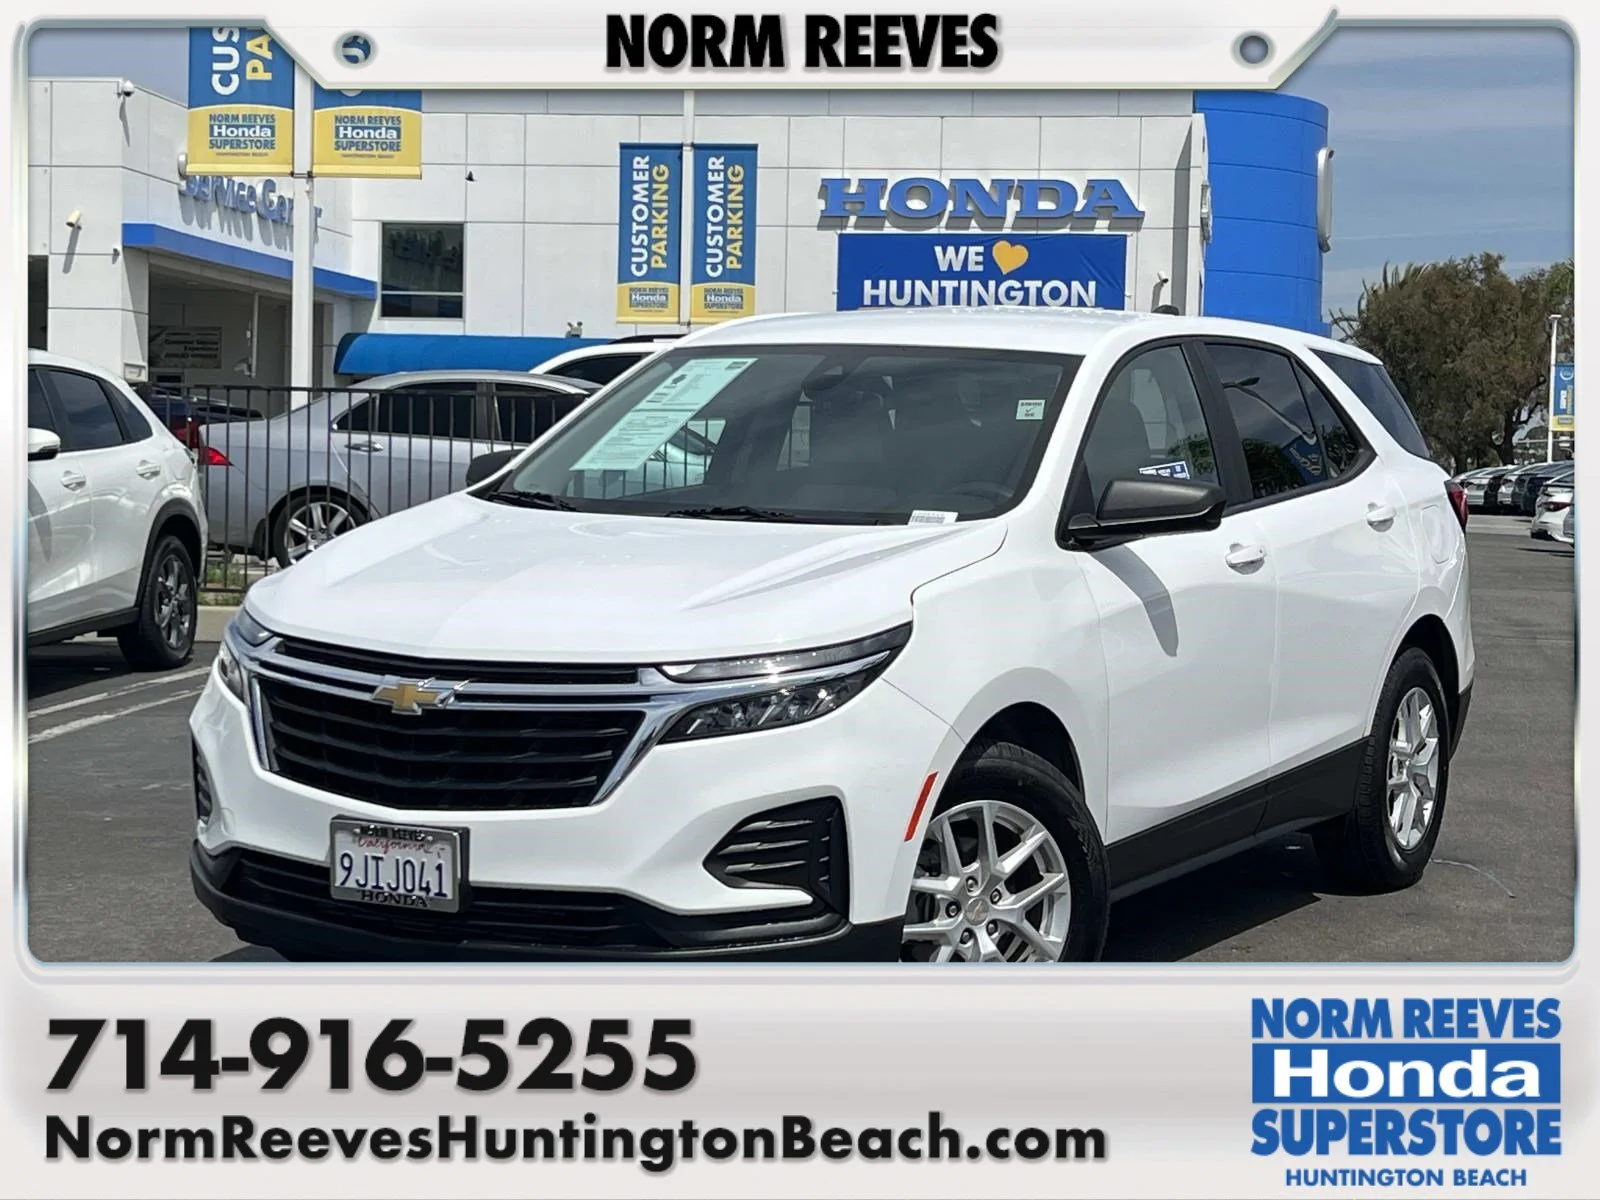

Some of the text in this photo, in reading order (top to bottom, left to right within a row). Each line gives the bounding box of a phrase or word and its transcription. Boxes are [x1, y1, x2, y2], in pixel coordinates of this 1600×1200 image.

[209, 114, 275, 123] NORM REEVES
[335, 115, 401, 125] NORM REEVES
[213, 125, 272, 138] Honda
[339, 127, 398, 139] Honda
[209, 139, 275, 150] SUPERSTORE
[334, 140, 401, 152] SUPERSTORE
[819, 177, 1146, 220] HONDA
[631, 155, 650, 277] CUSTOMER
[651, 164, 670, 269] PARKING
[705, 155, 725, 278] CUSTOMER
[726, 164, 745, 270] PARKING
[934, 245, 984, 273] WE
[632, 292, 667, 301] Honda
[707, 293, 742, 302] Honda
[863, 279, 1096, 307] HUNTINGTON
[340, 852, 447, 898] 9JIJ041
[361, 891, 428, 908] HONDA
